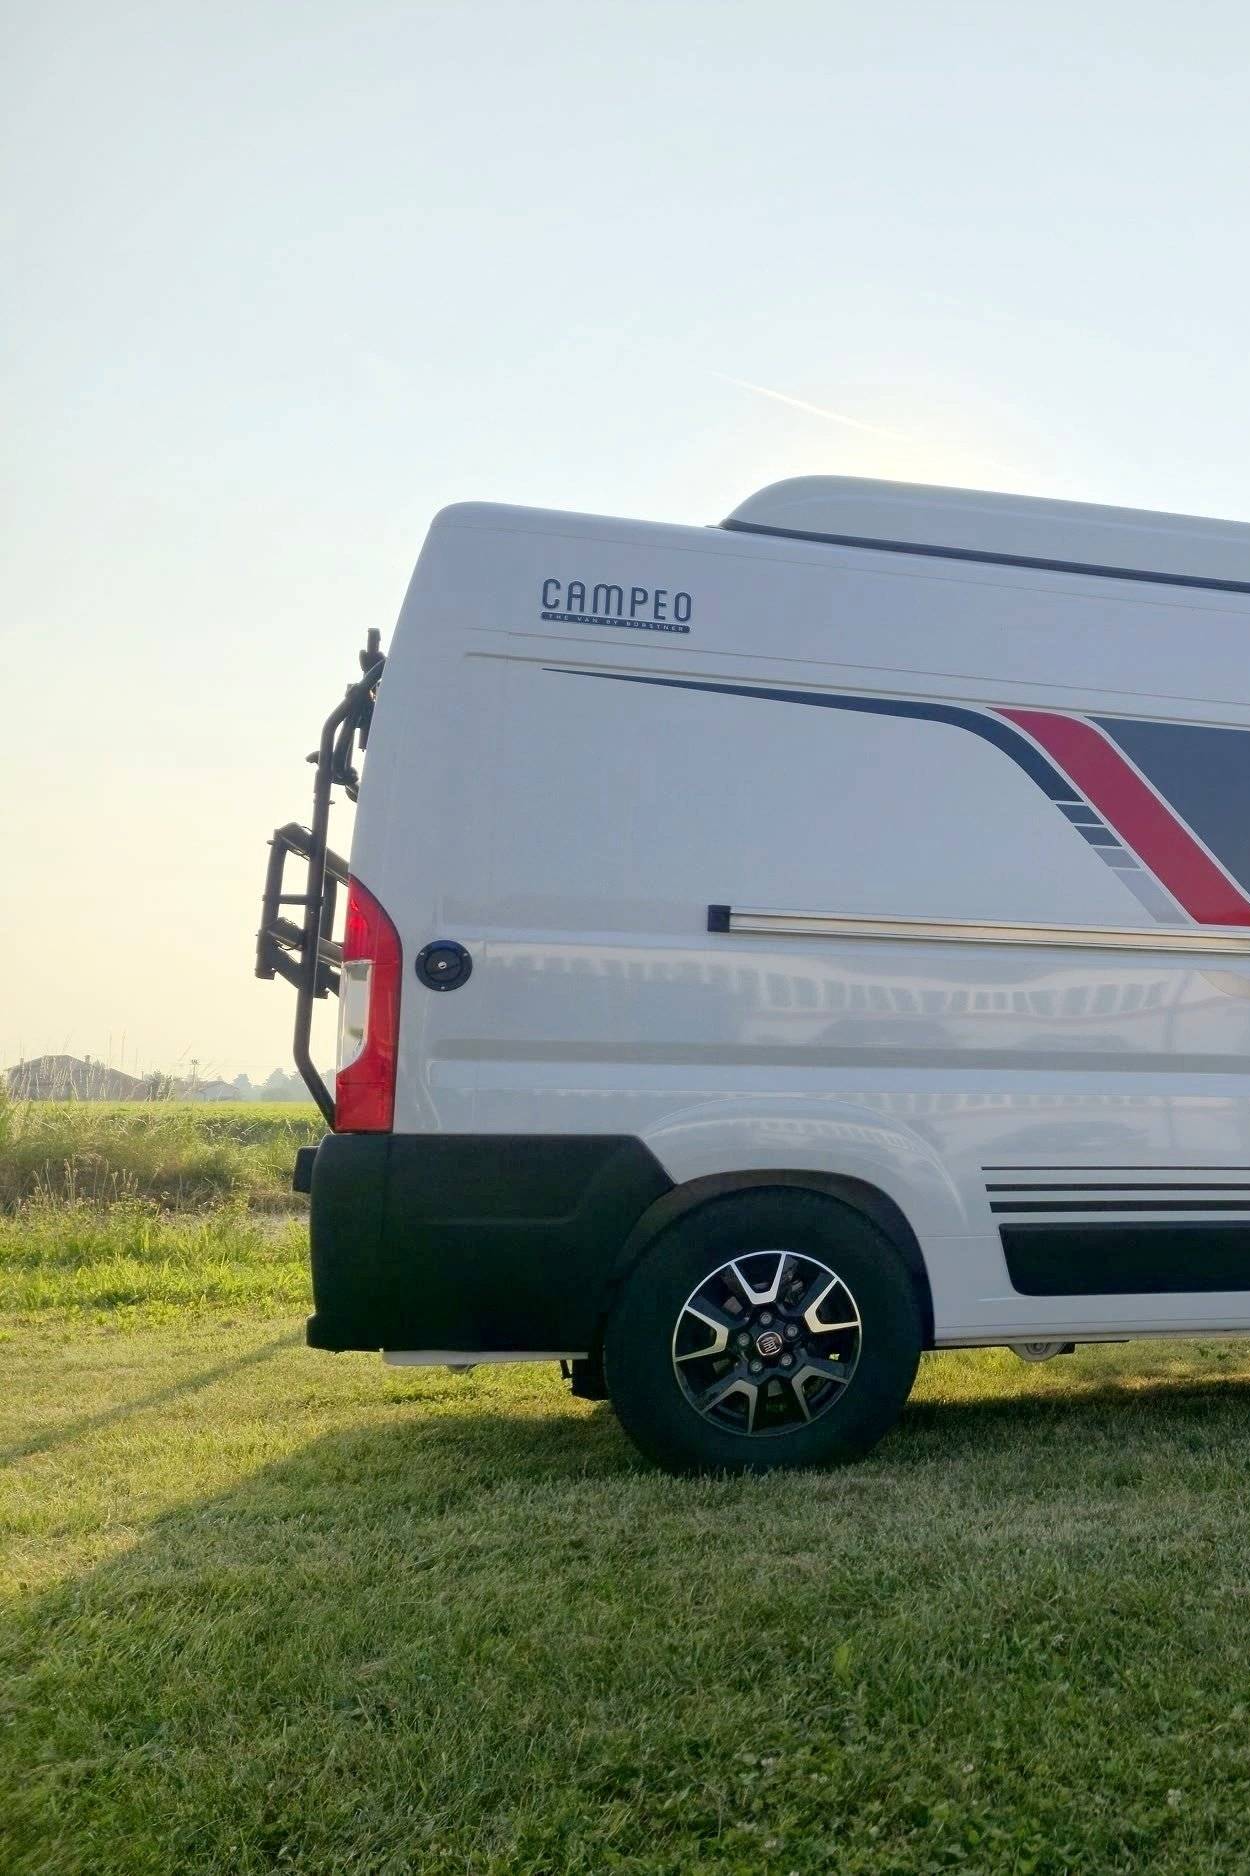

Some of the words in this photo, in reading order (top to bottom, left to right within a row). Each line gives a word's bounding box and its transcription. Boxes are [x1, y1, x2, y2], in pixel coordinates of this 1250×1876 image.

[542, 578, 692, 621] CAMPEO
[549, 613, 569, 621] THE
[577, 616, 599, 624] VAN
[761, 1336, 777, 1352] FIAT
